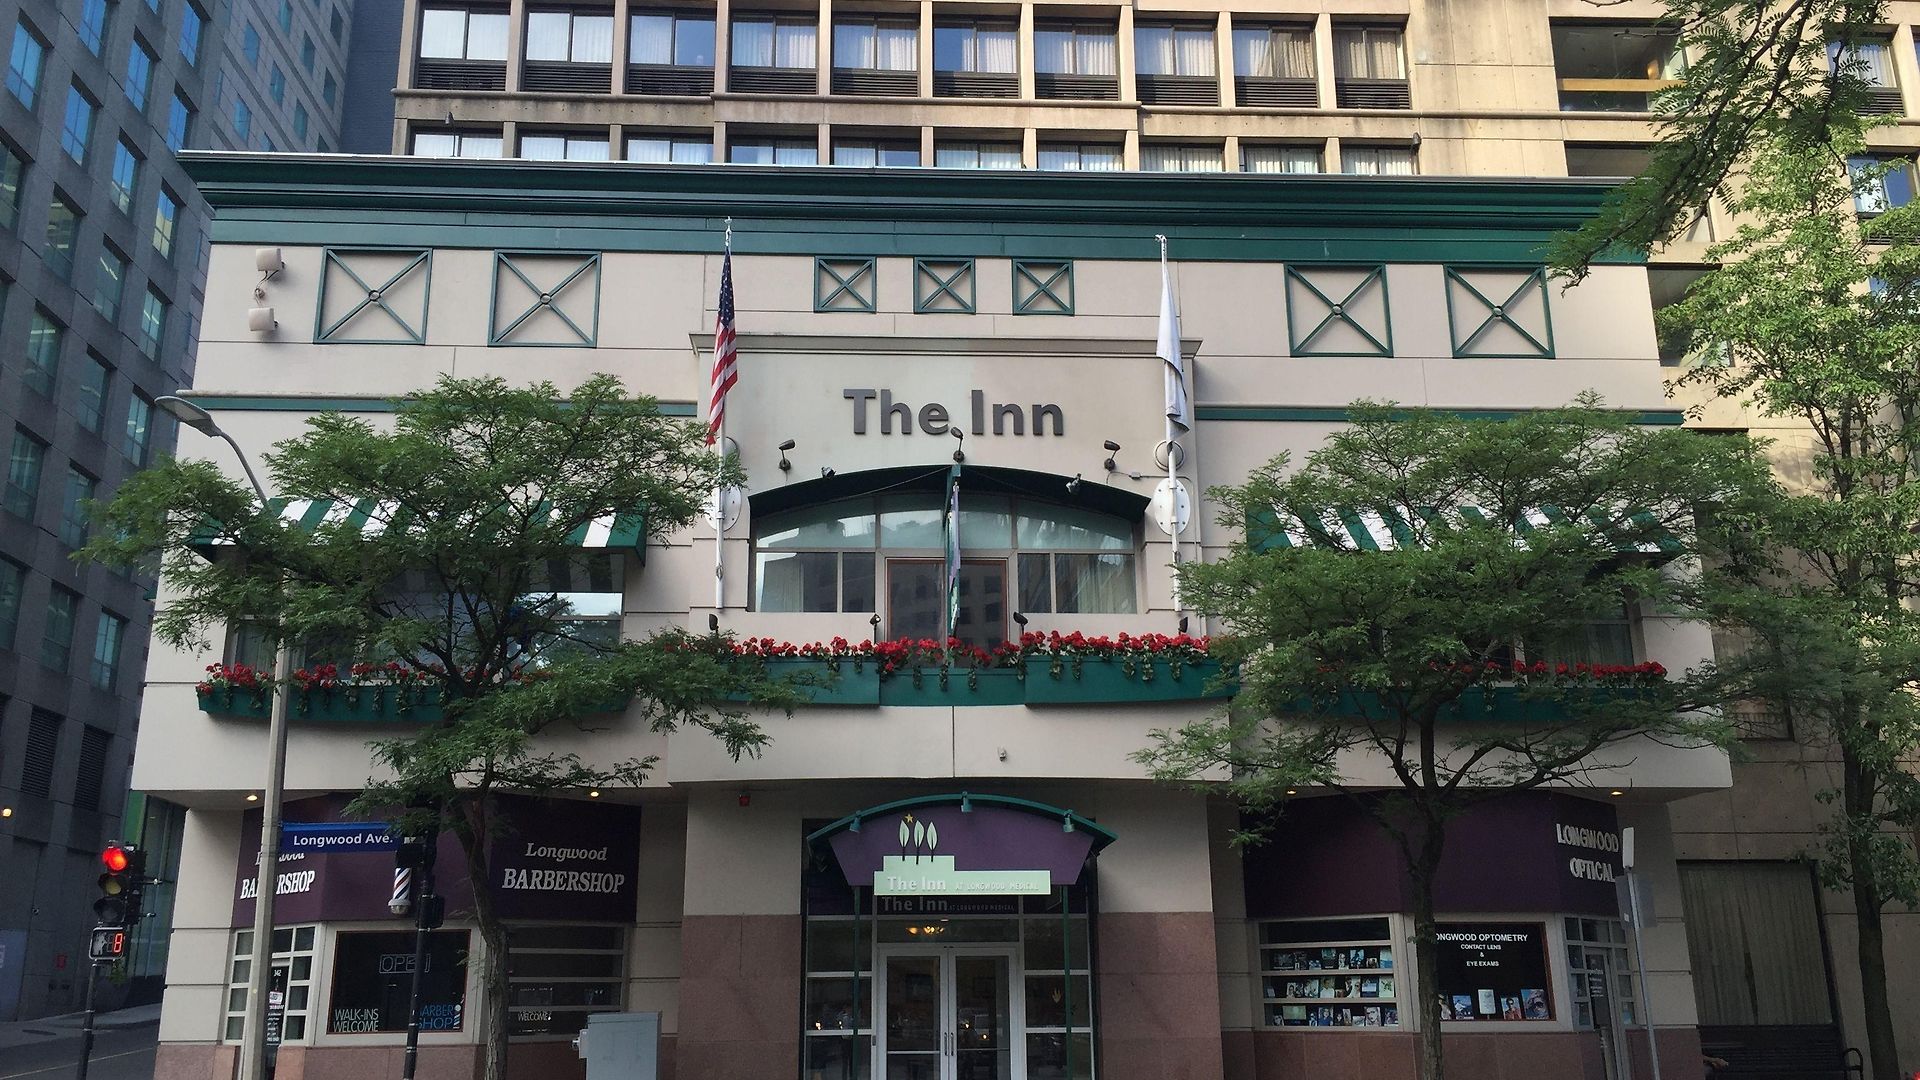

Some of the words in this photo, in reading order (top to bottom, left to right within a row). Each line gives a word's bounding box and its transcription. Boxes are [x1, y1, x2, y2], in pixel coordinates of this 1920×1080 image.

[843, 388, 949, 436] The
[971, 389, 1064, 436] Inn
[293, 833, 362, 847] Longwood
[365, 833, 393, 844] Ave.
[1556, 823, 1619, 852] LONGWOOD
[525, 842, 608, 862] Longwood
[1569, 857, 1616, 883] OPTICAL
[240, 870, 315, 899] BARSHOP
[501, 868, 625, 893] BARBERSHOP
[887, 876, 917, 891] The
[922, 876, 947, 891] Inn
[967, 882, 1006, 891] LONGWOOD
[1009, 882, 1040, 891] MEDICAL
[881, 896, 913, 912] The
[919, 897, 949, 912] Inn
[1436, 933, 1477, 942] NGWOOD
[1478, 934, 1528, 942] OPTOMETRY
[335, 1008, 379, 1021] WALK-INS
[333, 1020, 379, 1033] WELCOME
